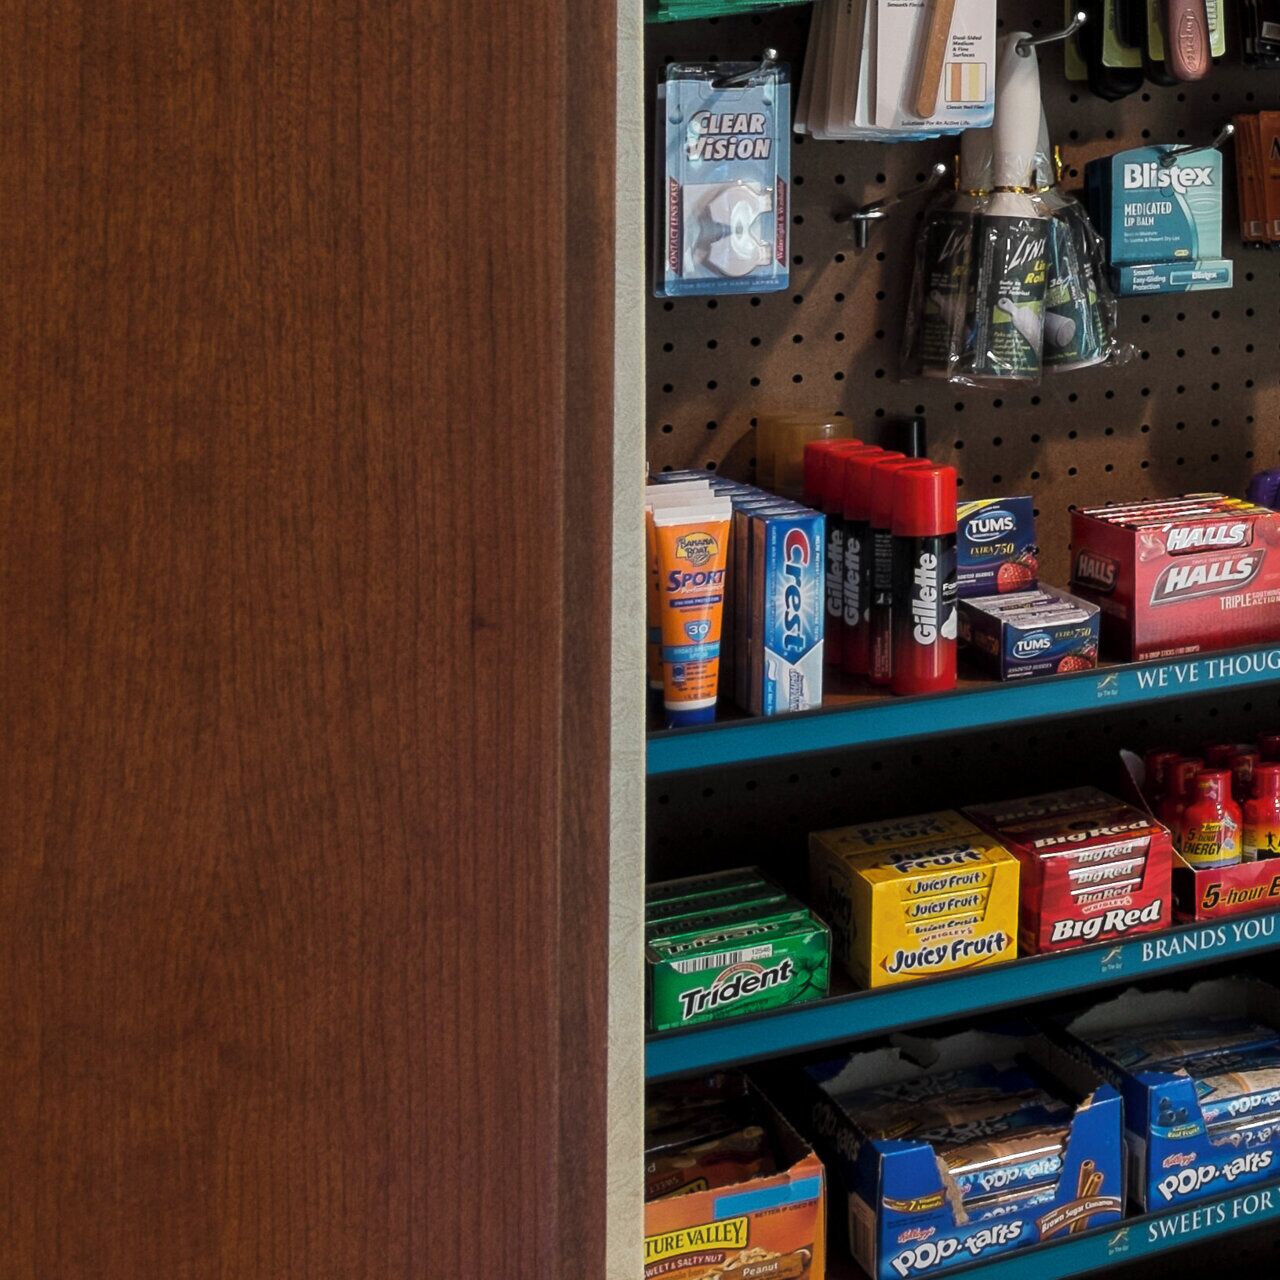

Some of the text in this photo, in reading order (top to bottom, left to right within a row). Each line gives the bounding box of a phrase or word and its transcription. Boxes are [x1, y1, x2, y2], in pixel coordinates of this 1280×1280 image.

[690, 110, 766, 135] CLEAR
[1124, 162, 1216, 194] Blistex
[1124, 201, 1172, 216] MEDICATED
[1124, 216, 1154, 227] LIP BALM
[969, 516, 1014, 534] TUMS
[1166, 521, 1247, 551] HALLS
[844, 537, 860, 626] Gillette
[1164, 557, 1256, 593] HALLS
[784, 527, 811, 652] Crest
[912, 551, 937, 646] Gillette
[1220, 593, 1252, 610] TRIPLE
[689, 623, 708, 635] 30
[1017, 638, 1051, 652] TUMS
[1136, 665, 1199, 690] WE'VE
[1201, 883, 1266, 909] 5-hour
[1142, 926, 1226, 962] BRANDS
[1233, 913, 1276, 942] YOU
[889, 932, 1006, 975] Juicy Fruit
[679, 958, 795, 1019] Trident
[1147, 1207, 1226, 1243] SWEETS
[1231, 1190, 1275, 1218] FOR
[743, 1261, 778, 1276] Peanut
